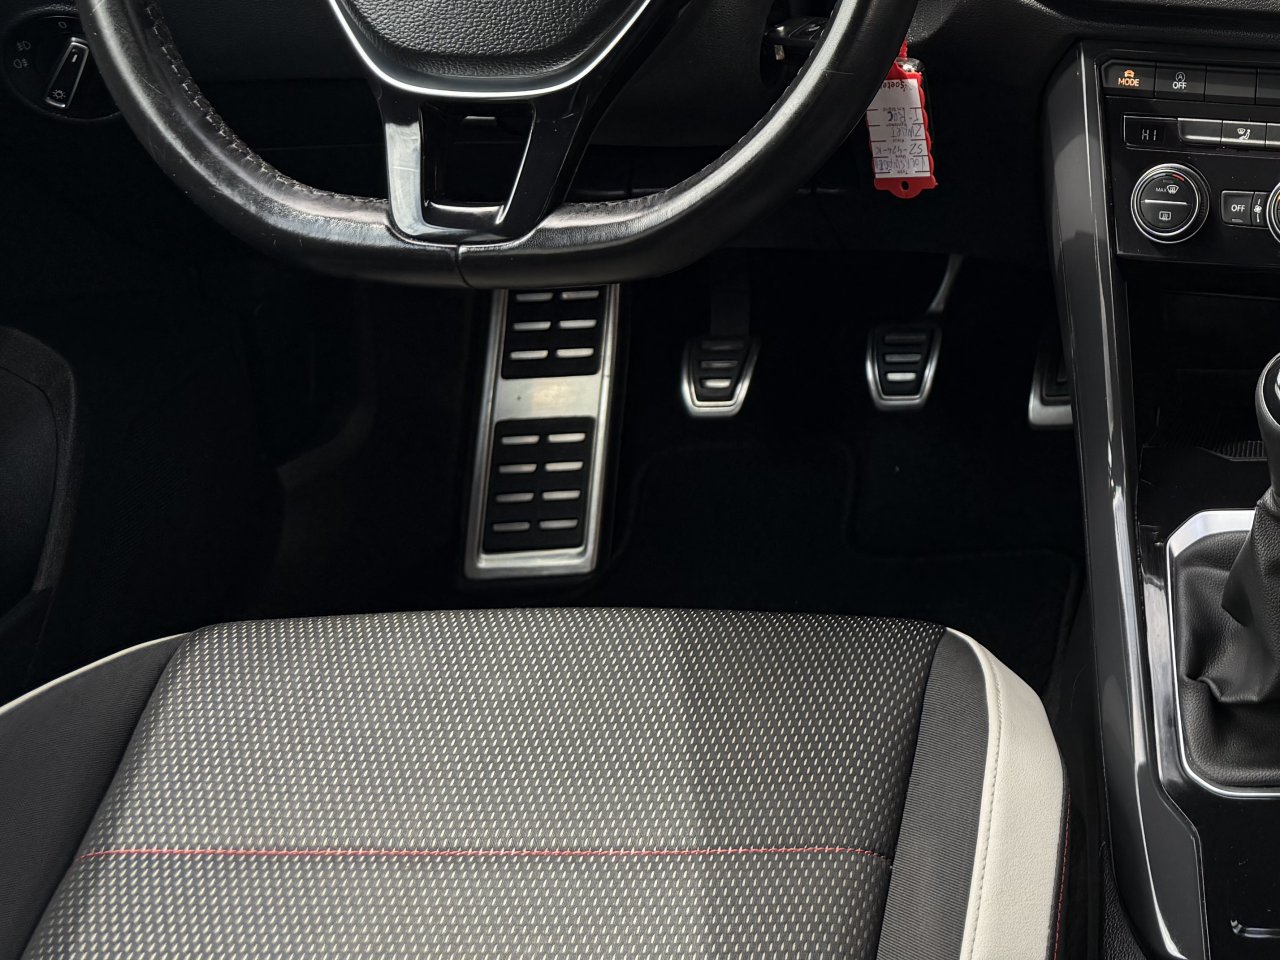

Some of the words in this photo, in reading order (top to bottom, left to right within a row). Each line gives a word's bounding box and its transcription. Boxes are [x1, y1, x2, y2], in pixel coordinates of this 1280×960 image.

[1117, 77, 1140, 87] MODE
[1172, 81, 1187, 90] OFF
[1231, 204, 1246, 213] OFF
